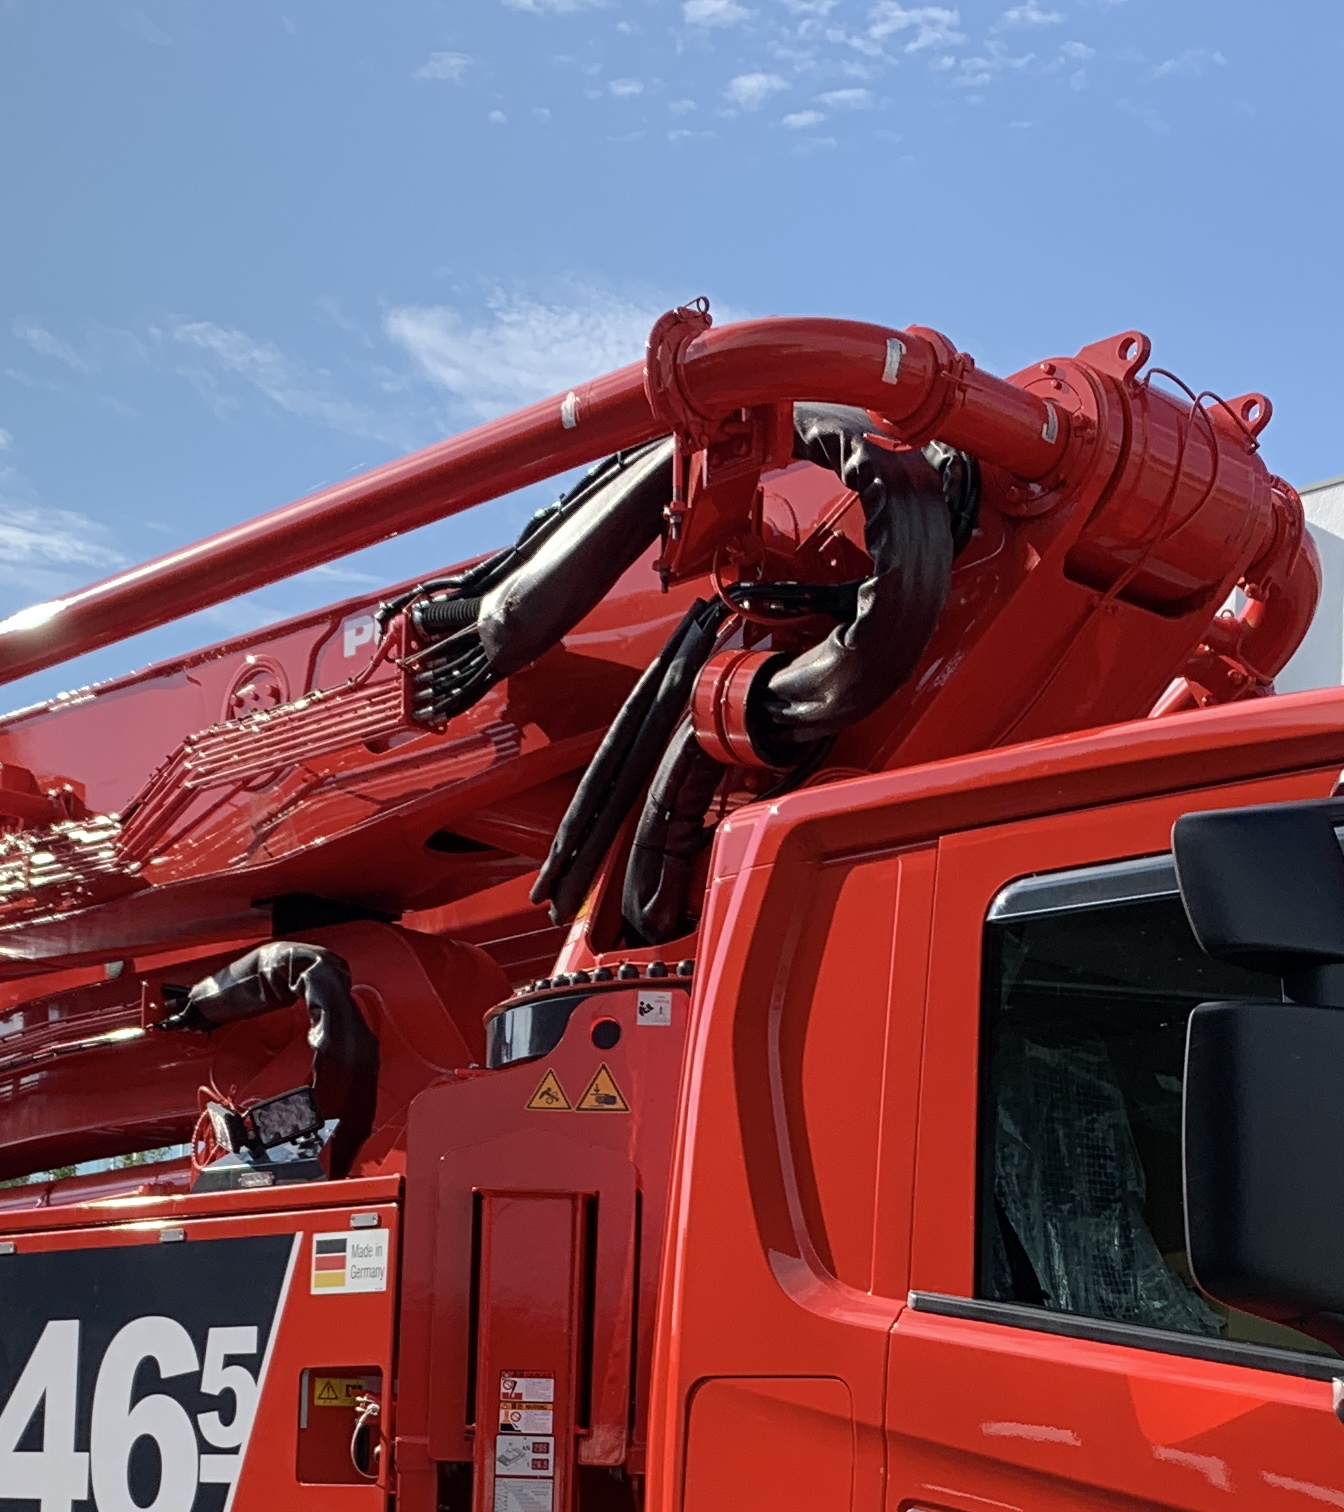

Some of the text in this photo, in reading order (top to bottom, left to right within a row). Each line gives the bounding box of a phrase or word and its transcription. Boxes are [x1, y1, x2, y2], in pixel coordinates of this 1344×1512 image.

[351, 1242, 383, 1259] Made in
[350, 1264, 386, 1281] Germany
